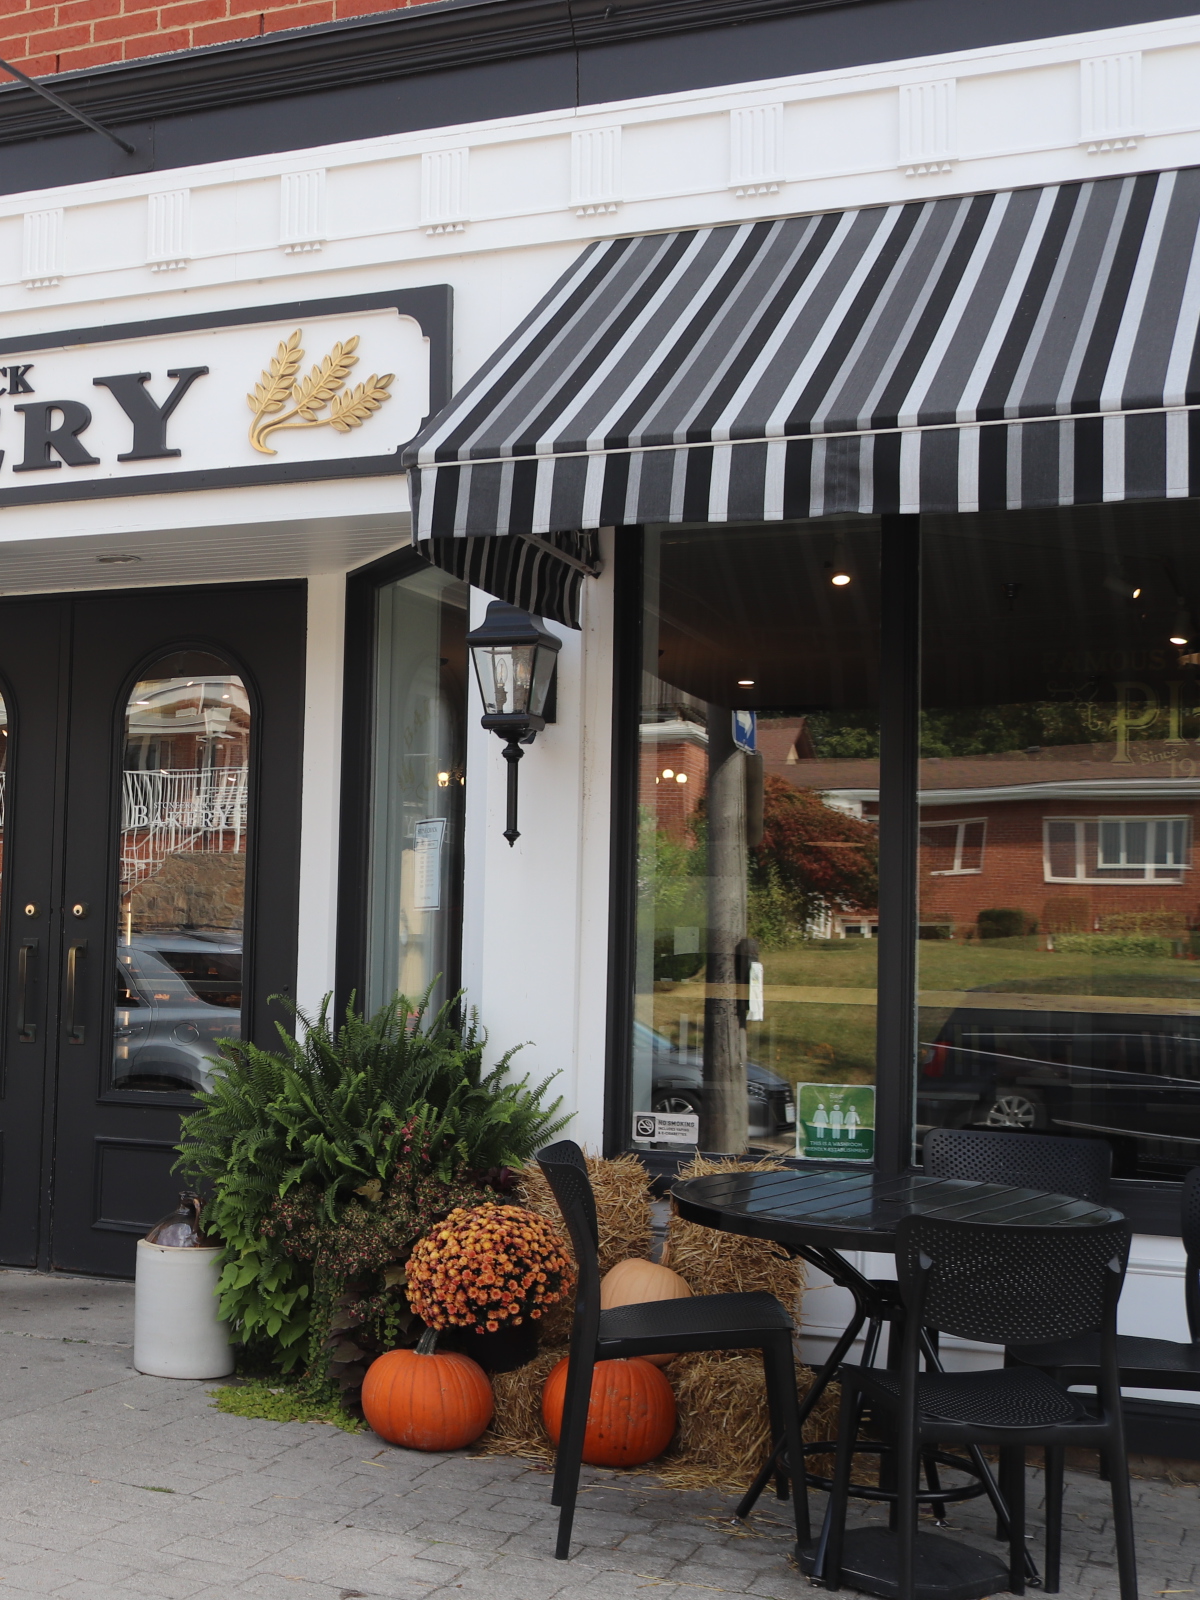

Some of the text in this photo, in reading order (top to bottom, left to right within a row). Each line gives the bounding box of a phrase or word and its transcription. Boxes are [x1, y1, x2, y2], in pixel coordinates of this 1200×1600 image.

[1138, 748, 1180, 766] Since
[133, 804, 234, 829] BAKERY
[667, 1120, 695, 1128] SMOKING
